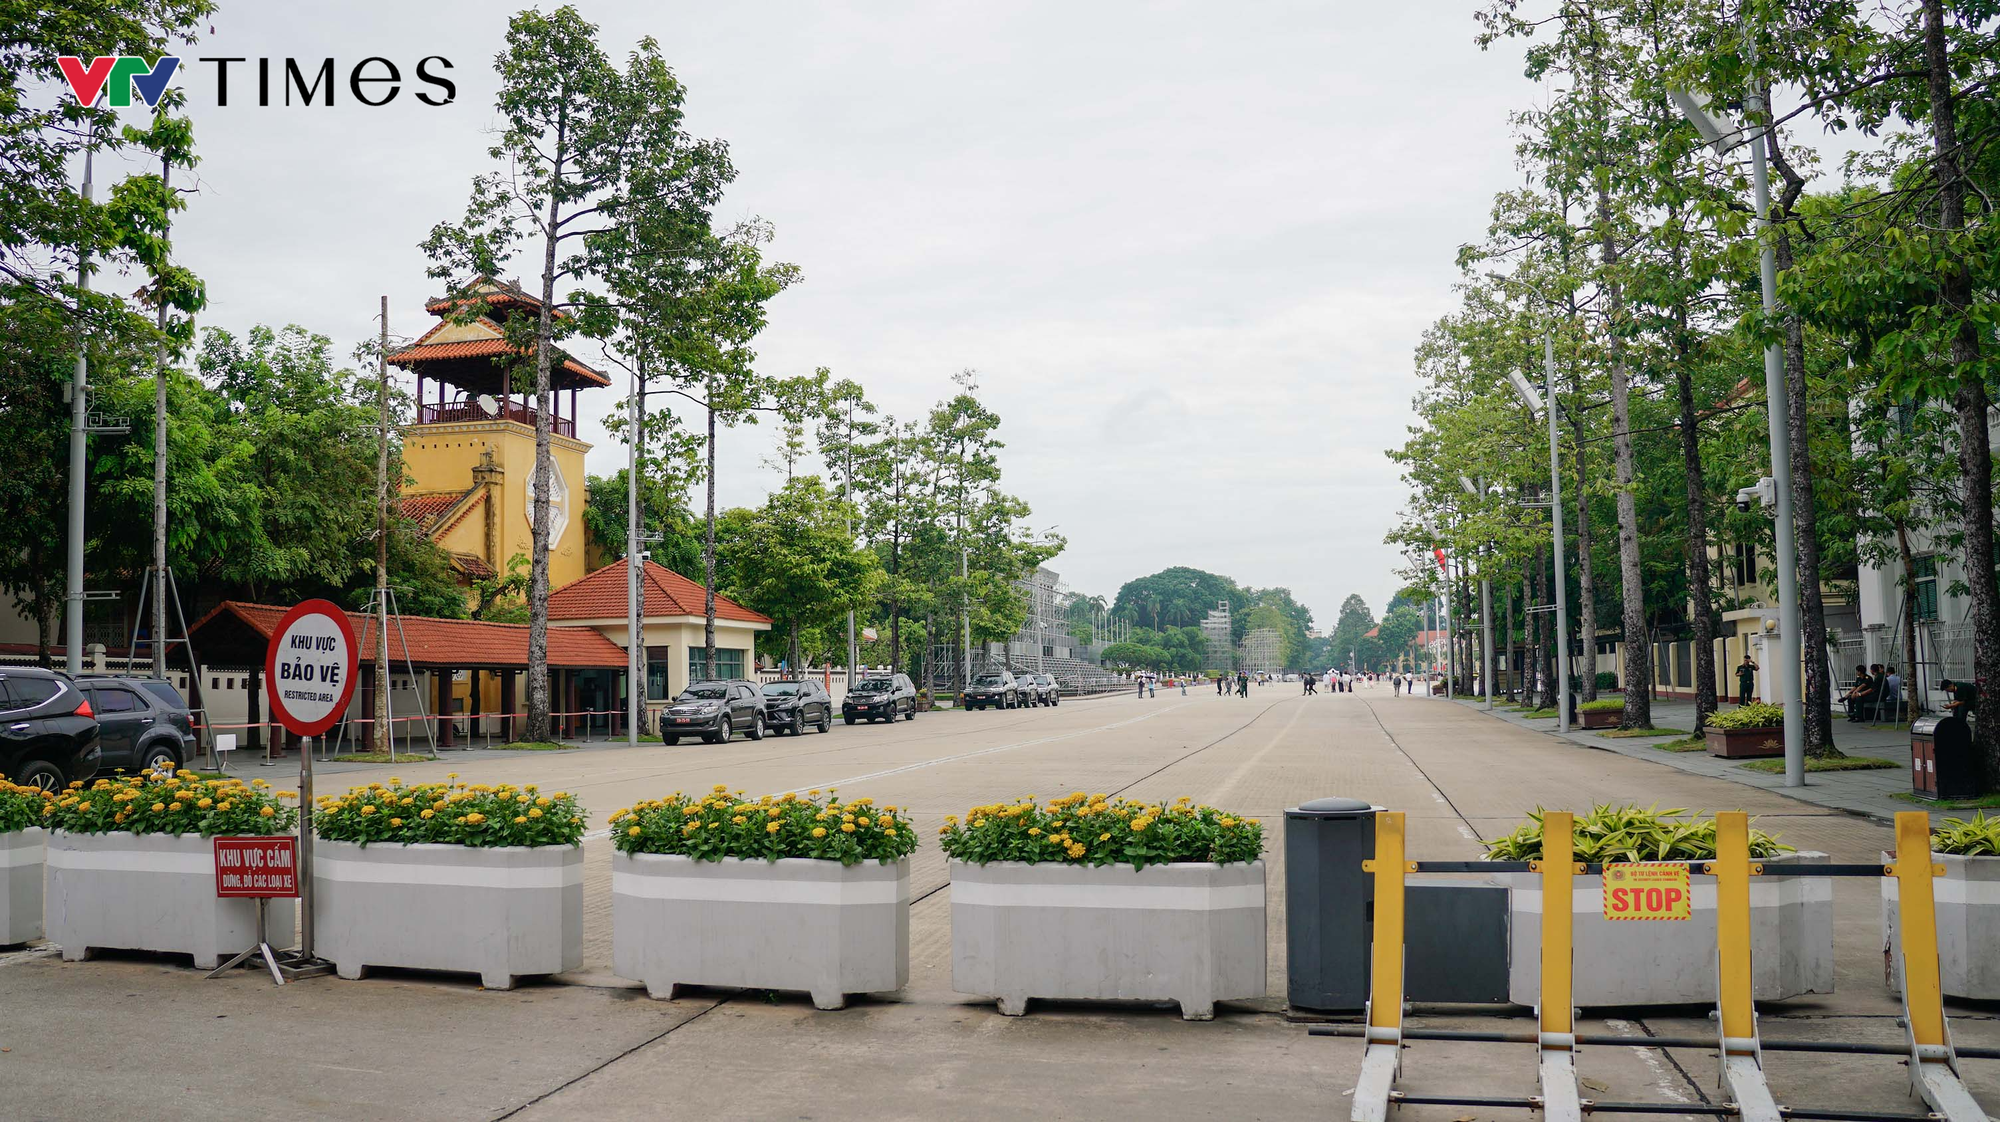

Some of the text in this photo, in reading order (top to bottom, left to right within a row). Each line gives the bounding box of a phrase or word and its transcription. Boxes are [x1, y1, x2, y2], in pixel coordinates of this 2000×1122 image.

[290, 635, 336, 654] KHU VỰC
[280, 656, 340, 687] BẢO VỆ
[284, 690, 334, 703] RESTRICTED AREA
[219, 843, 291, 870] KHU VỰC CẤM
[253, 871, 267, 888] CÁC
[267, 874, 283, 890] LOẠI
[283, 874, 292, 888] XE
[1611, 887, 1682, 912] STOP
